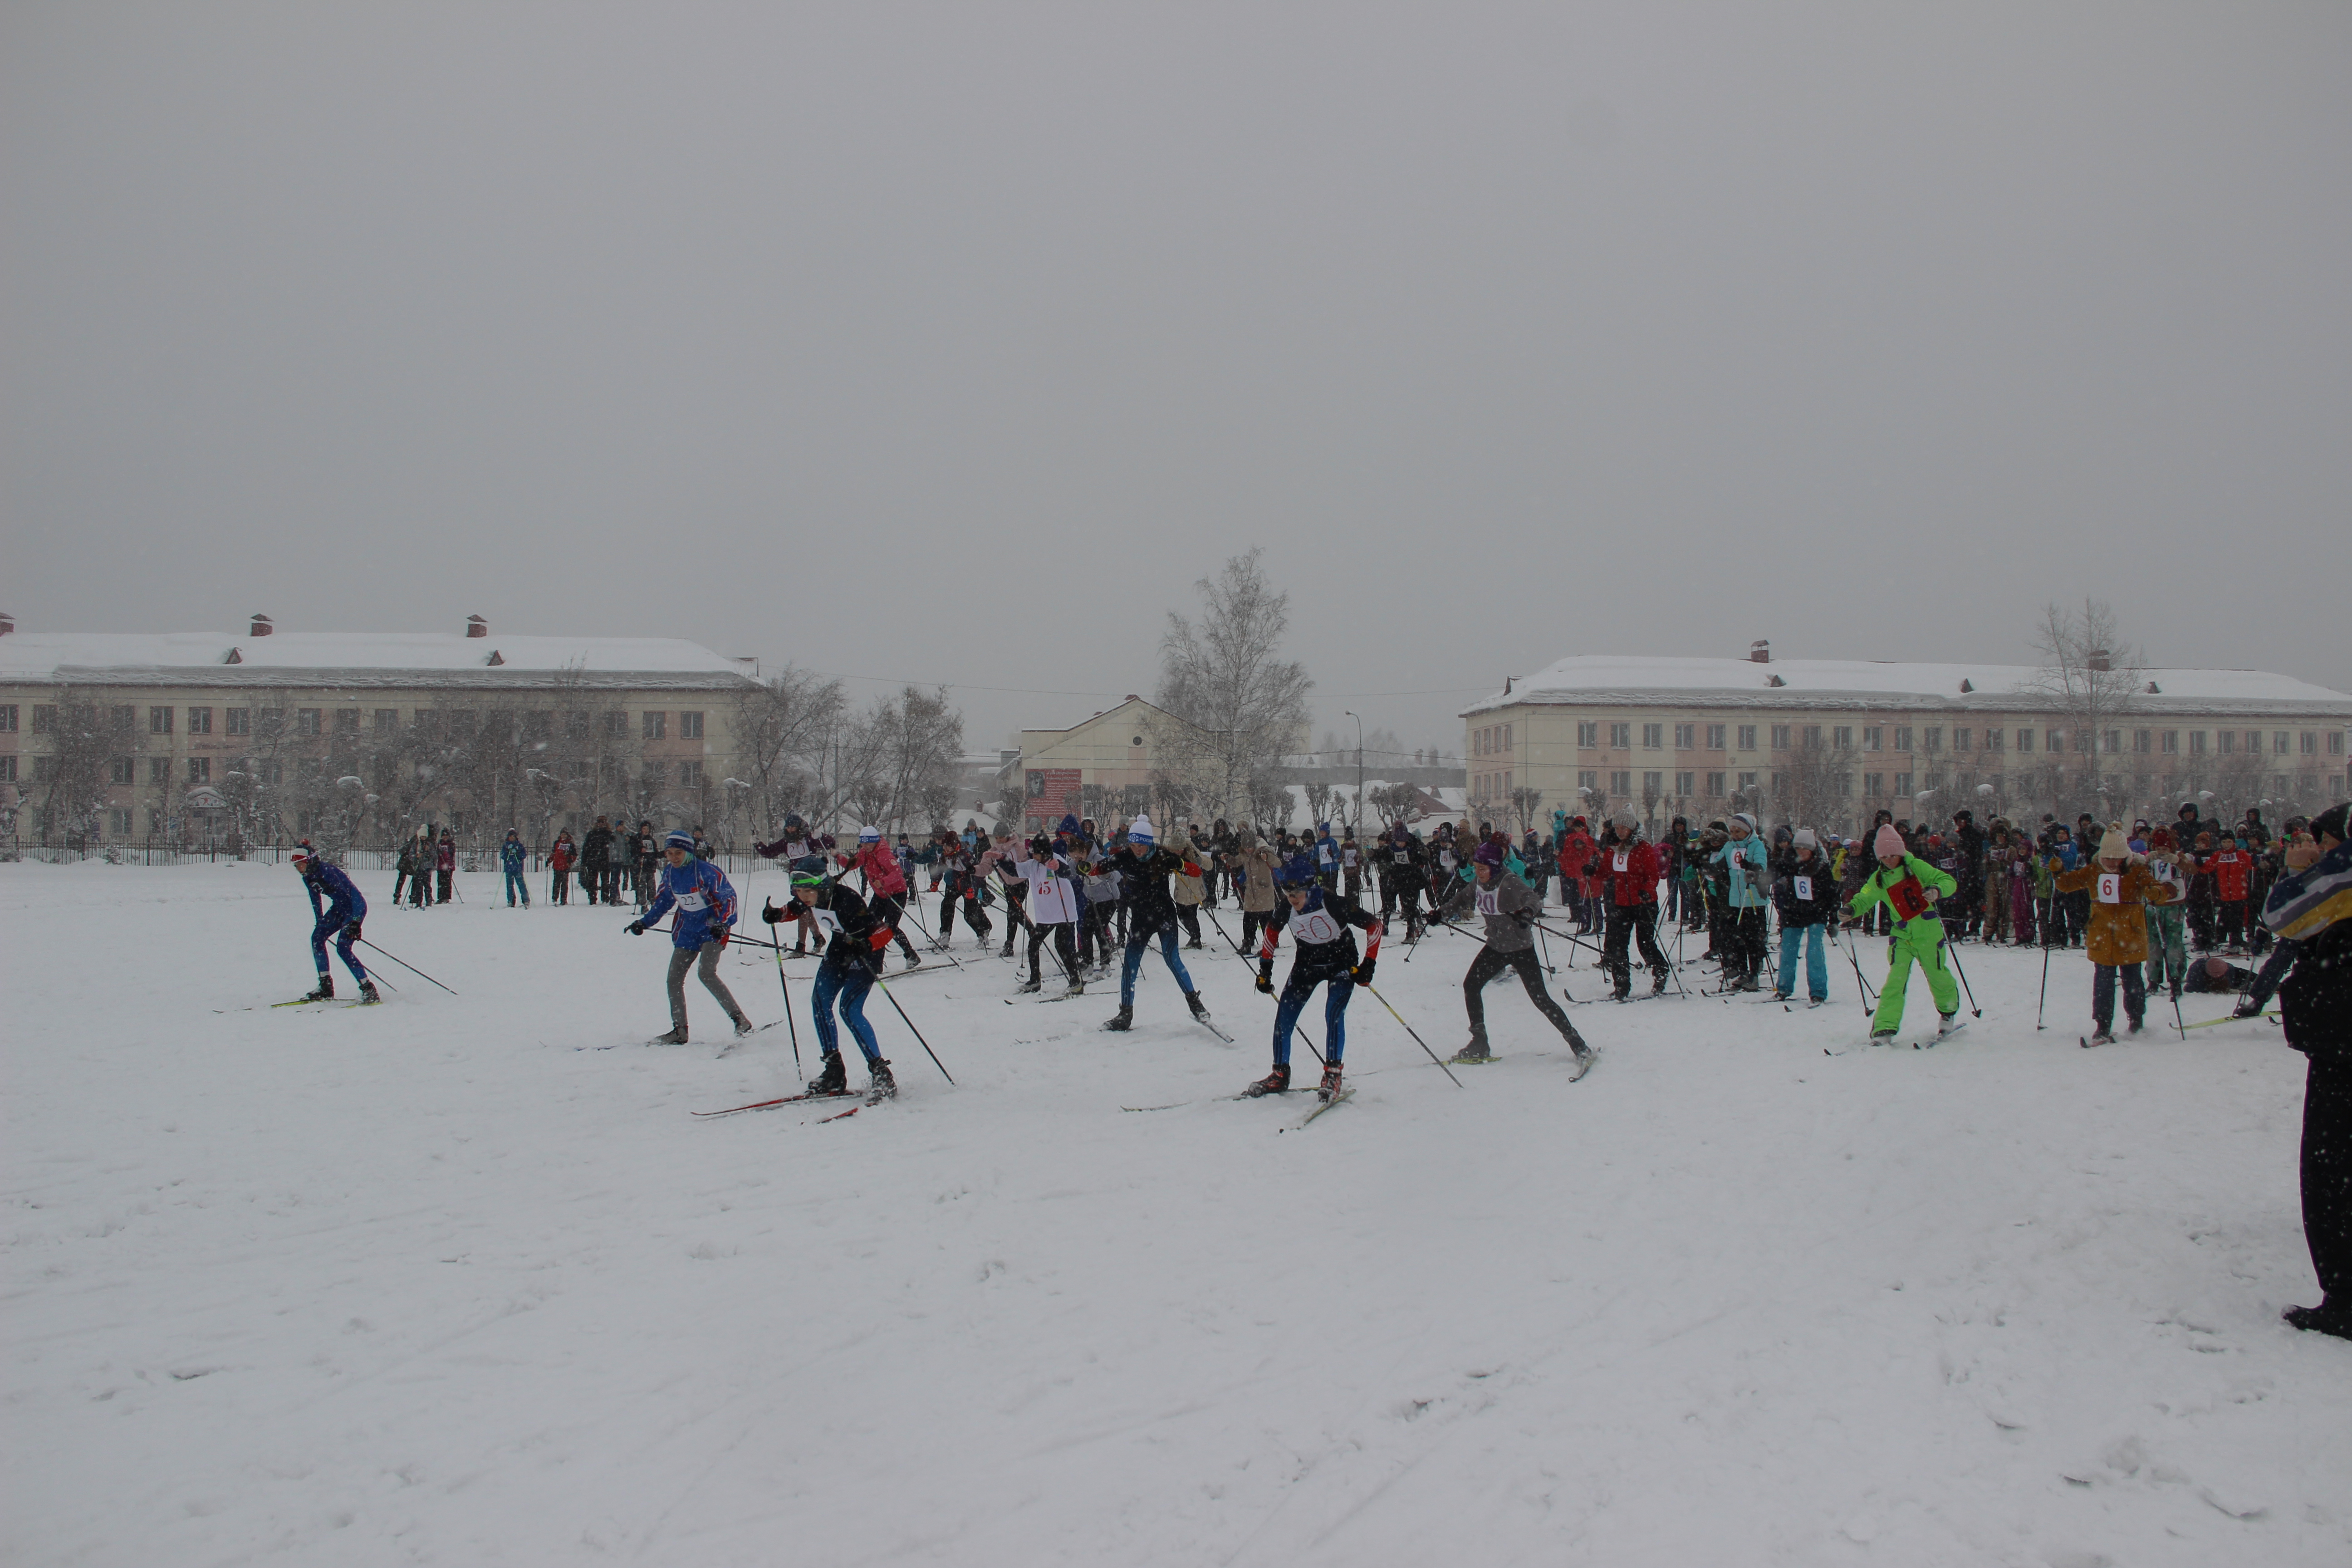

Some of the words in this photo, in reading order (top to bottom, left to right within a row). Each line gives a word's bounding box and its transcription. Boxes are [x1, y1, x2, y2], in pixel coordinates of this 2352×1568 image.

[790, 843, 805, 858] 20
[1321, 848, 1327, 859] 6
[1735, 851, 1742, 863] 6
[1347, 853, 1353, 862] 6
[1617, 853, 1625, 865] 6
[2158, 861, 2166, 874] 6
[1037, 881, 1051, 895] 15
[1799, 881, 1807, 894] 6
[2103, 879, 2112, 896] 6
[681, 896, 696, 905] 22
[1476, 891, 1494, 914] 20
[1903, 887, 1920, 911] 6
[1297, 916, 1332, 940] 20
